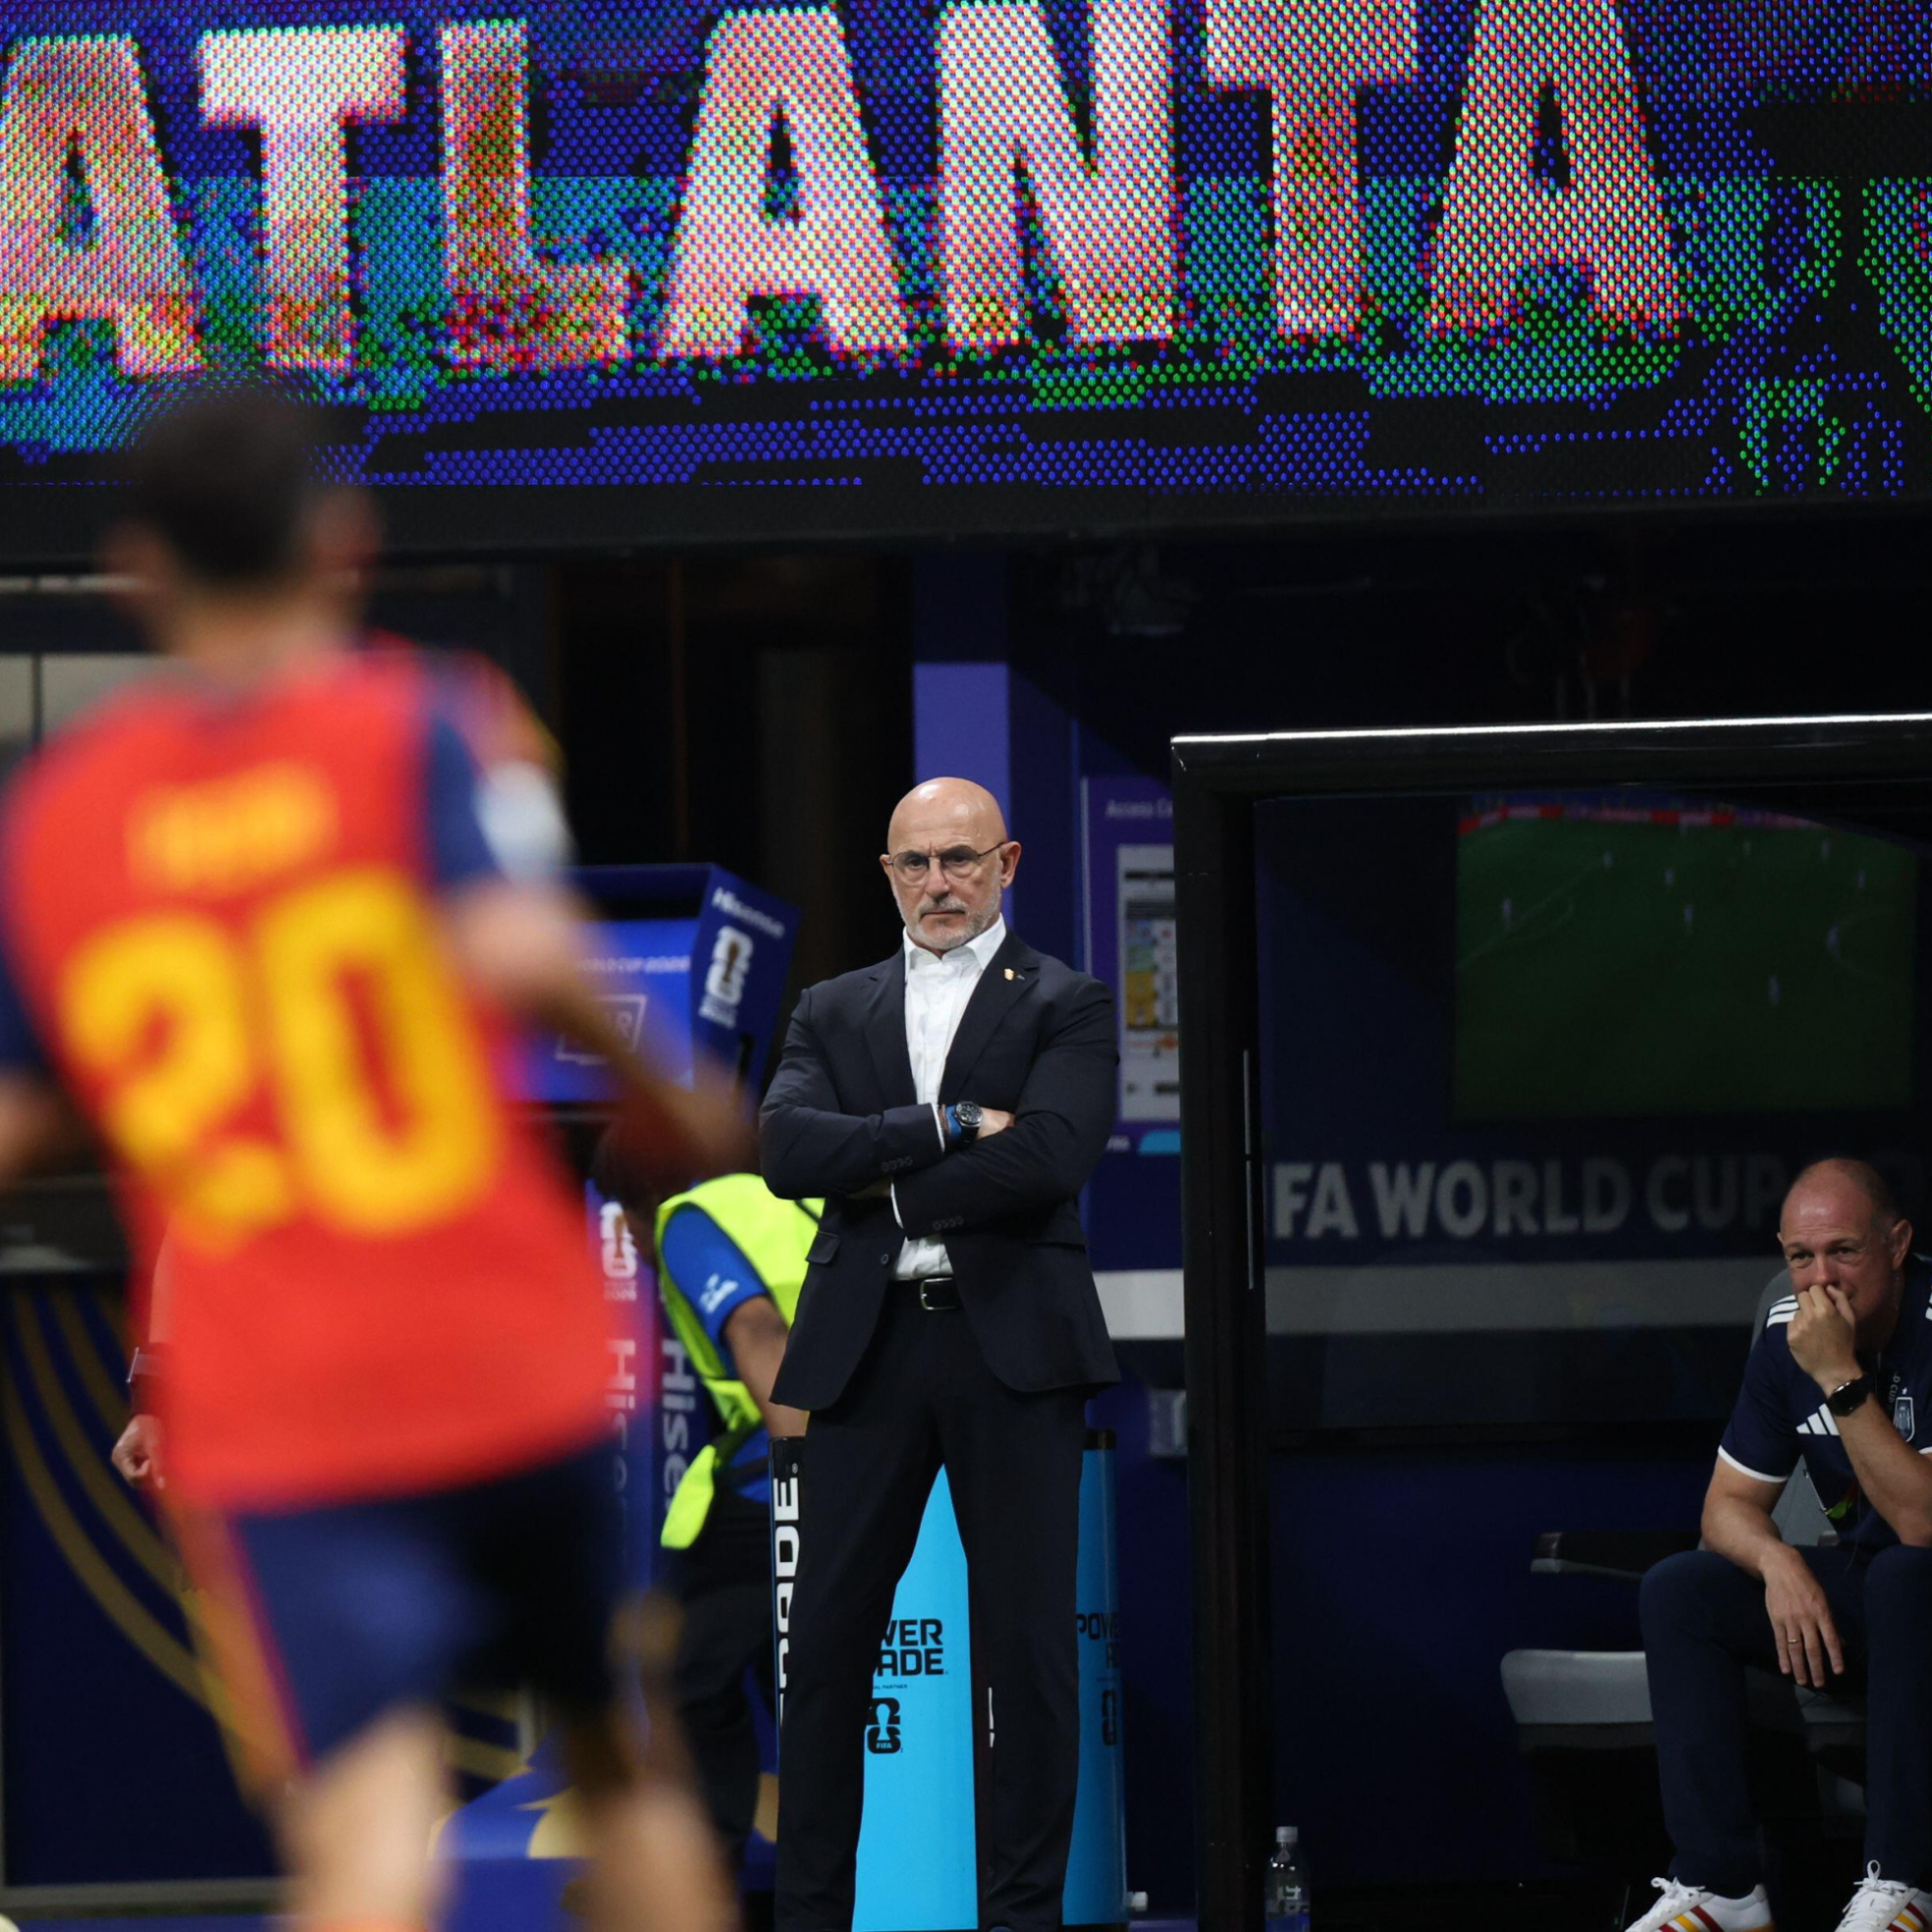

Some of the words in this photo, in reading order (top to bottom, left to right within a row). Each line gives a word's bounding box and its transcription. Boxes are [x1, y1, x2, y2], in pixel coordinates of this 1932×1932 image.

[0, 0, 1683, 381] ATLANTA
[59, 866, 499, 1239] 20
[1368, 1154, 1634, 1239] WORLD
[1645, 1150, 1791, 1234] CUP
